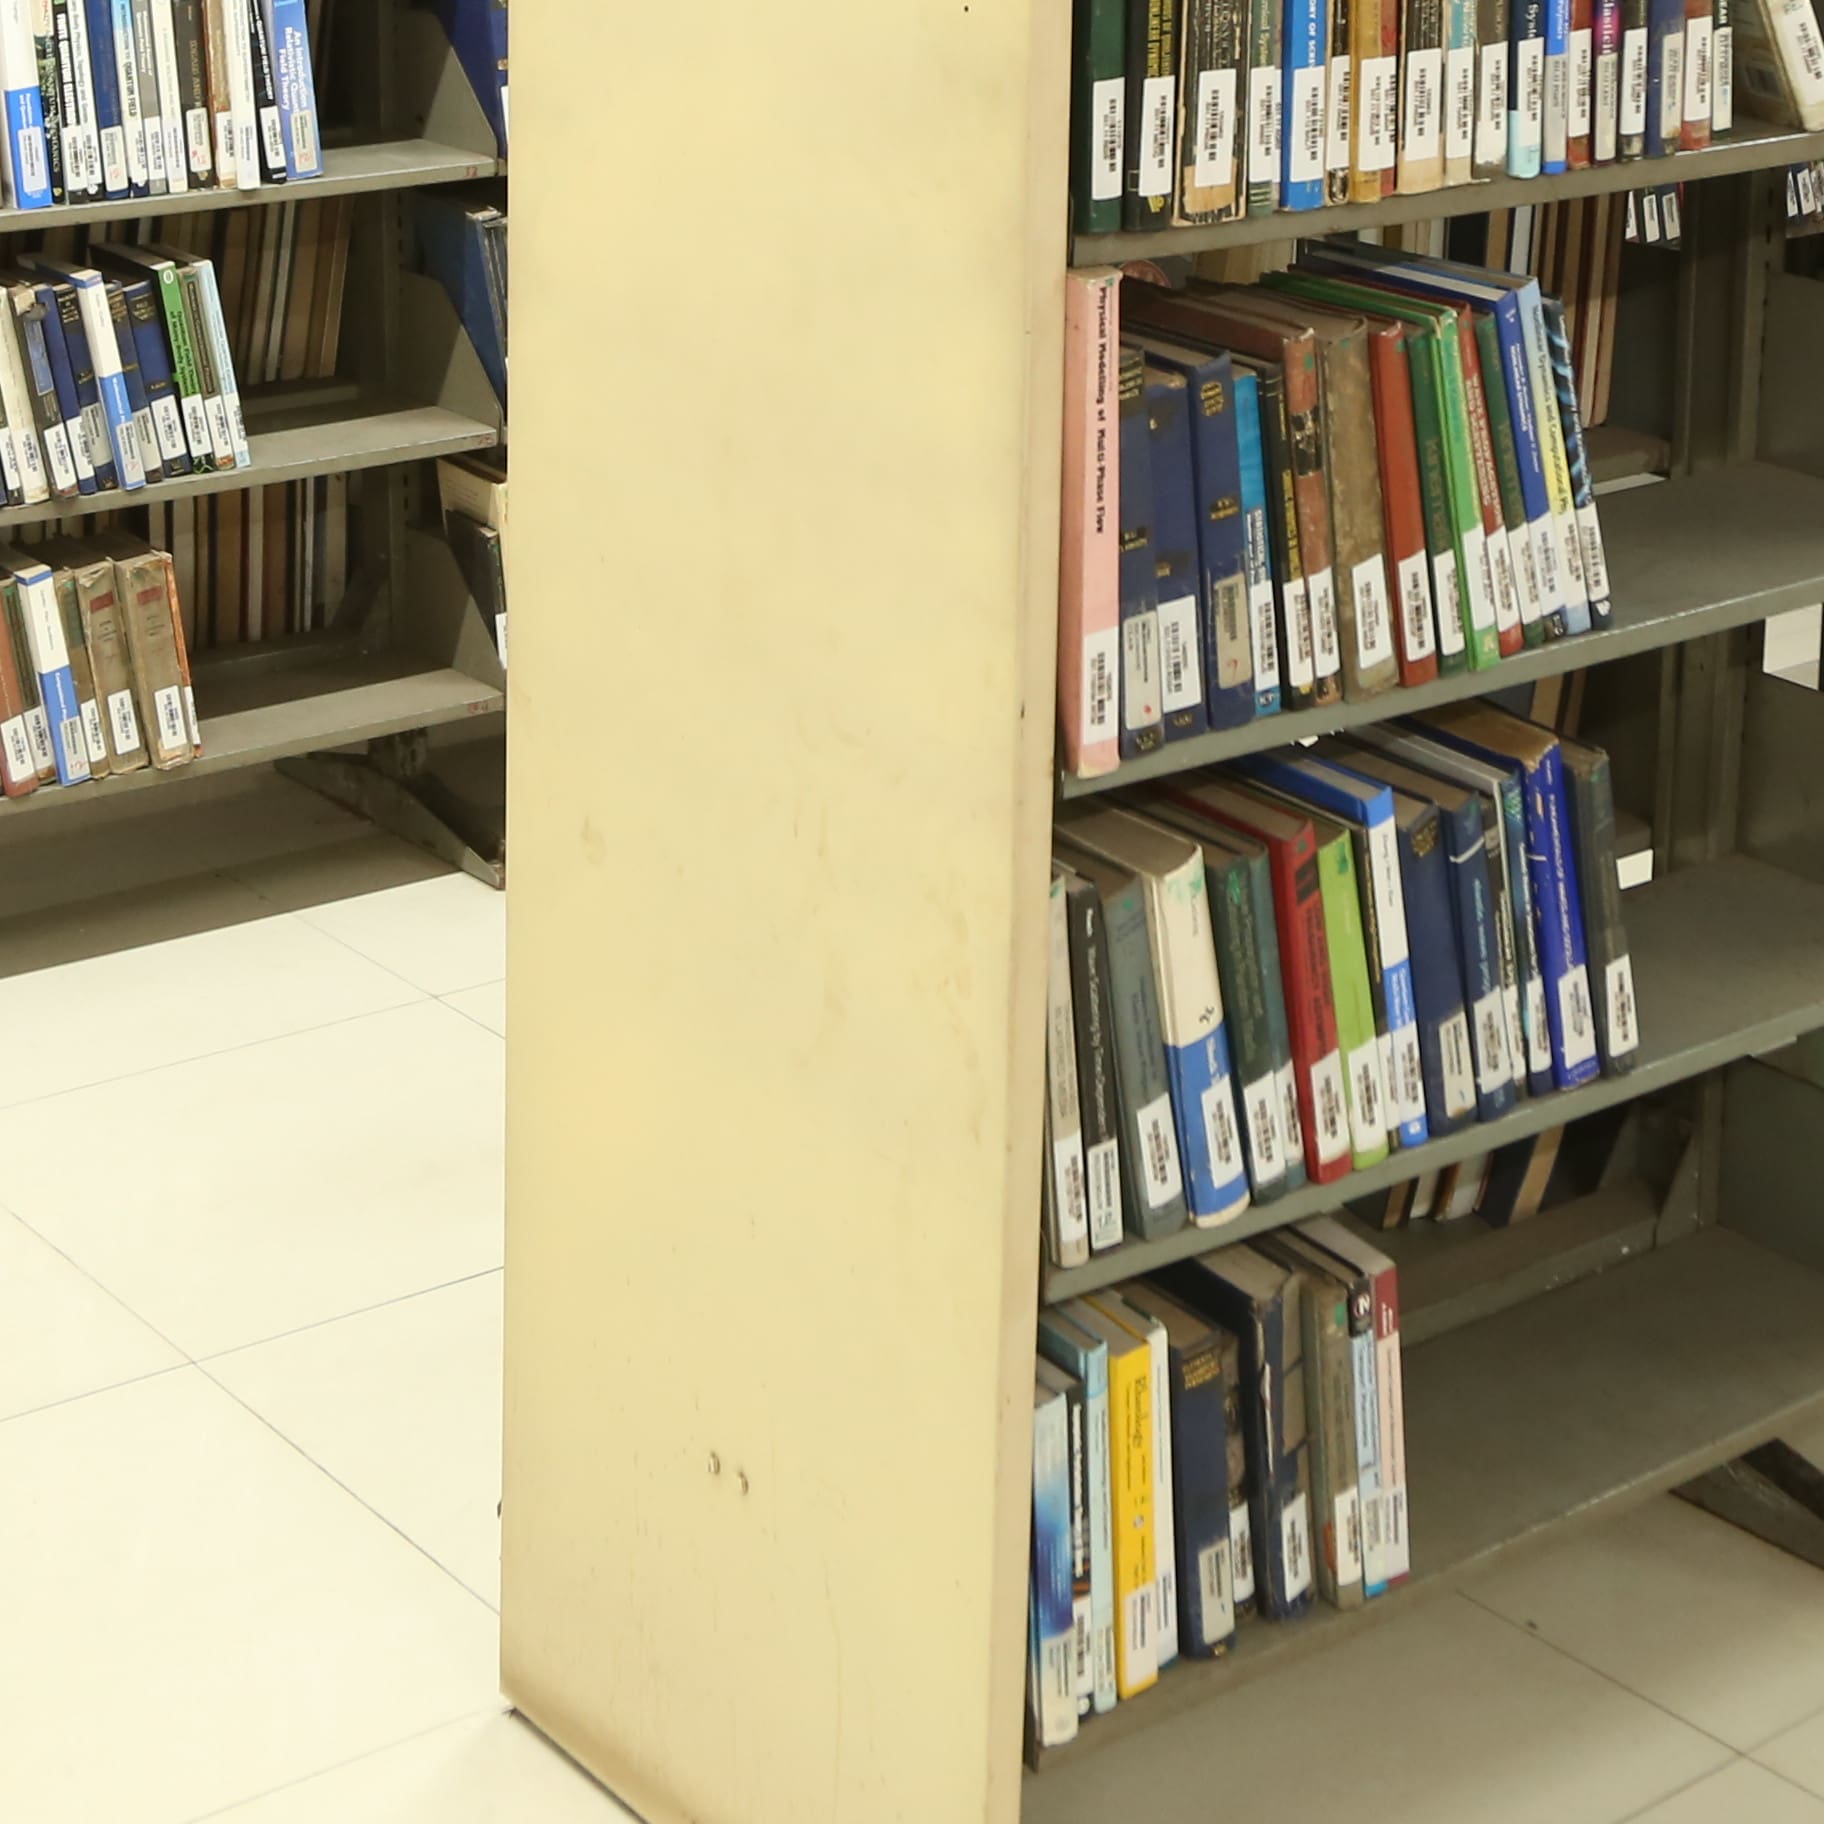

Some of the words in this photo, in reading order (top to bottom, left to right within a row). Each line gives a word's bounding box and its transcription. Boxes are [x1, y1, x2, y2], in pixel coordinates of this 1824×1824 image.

[1527, 4, 1540, 37] Syst
[279, 49, 289, 74] Field
[283, 28, 297, 80] Relativistic
[280, 76, 292, 111] Theory
[289, 83, 300, 114] Quant
[1095, 287, 1107, 339] Physical
[1531, 306, 1545, 353] Nonlinear
[1095, 343, 1108, 404] Modelling
[1536, 356, 1553, 401] Dynamics
[1097, 410, 1106, 421] of
[1546, 404, 1558, 421] and
[1096, 429, 1107, 501] Multi-Phase
[1546, 424, 1566, 494] Computational
[1096, 506, 1106, 534] Flow
